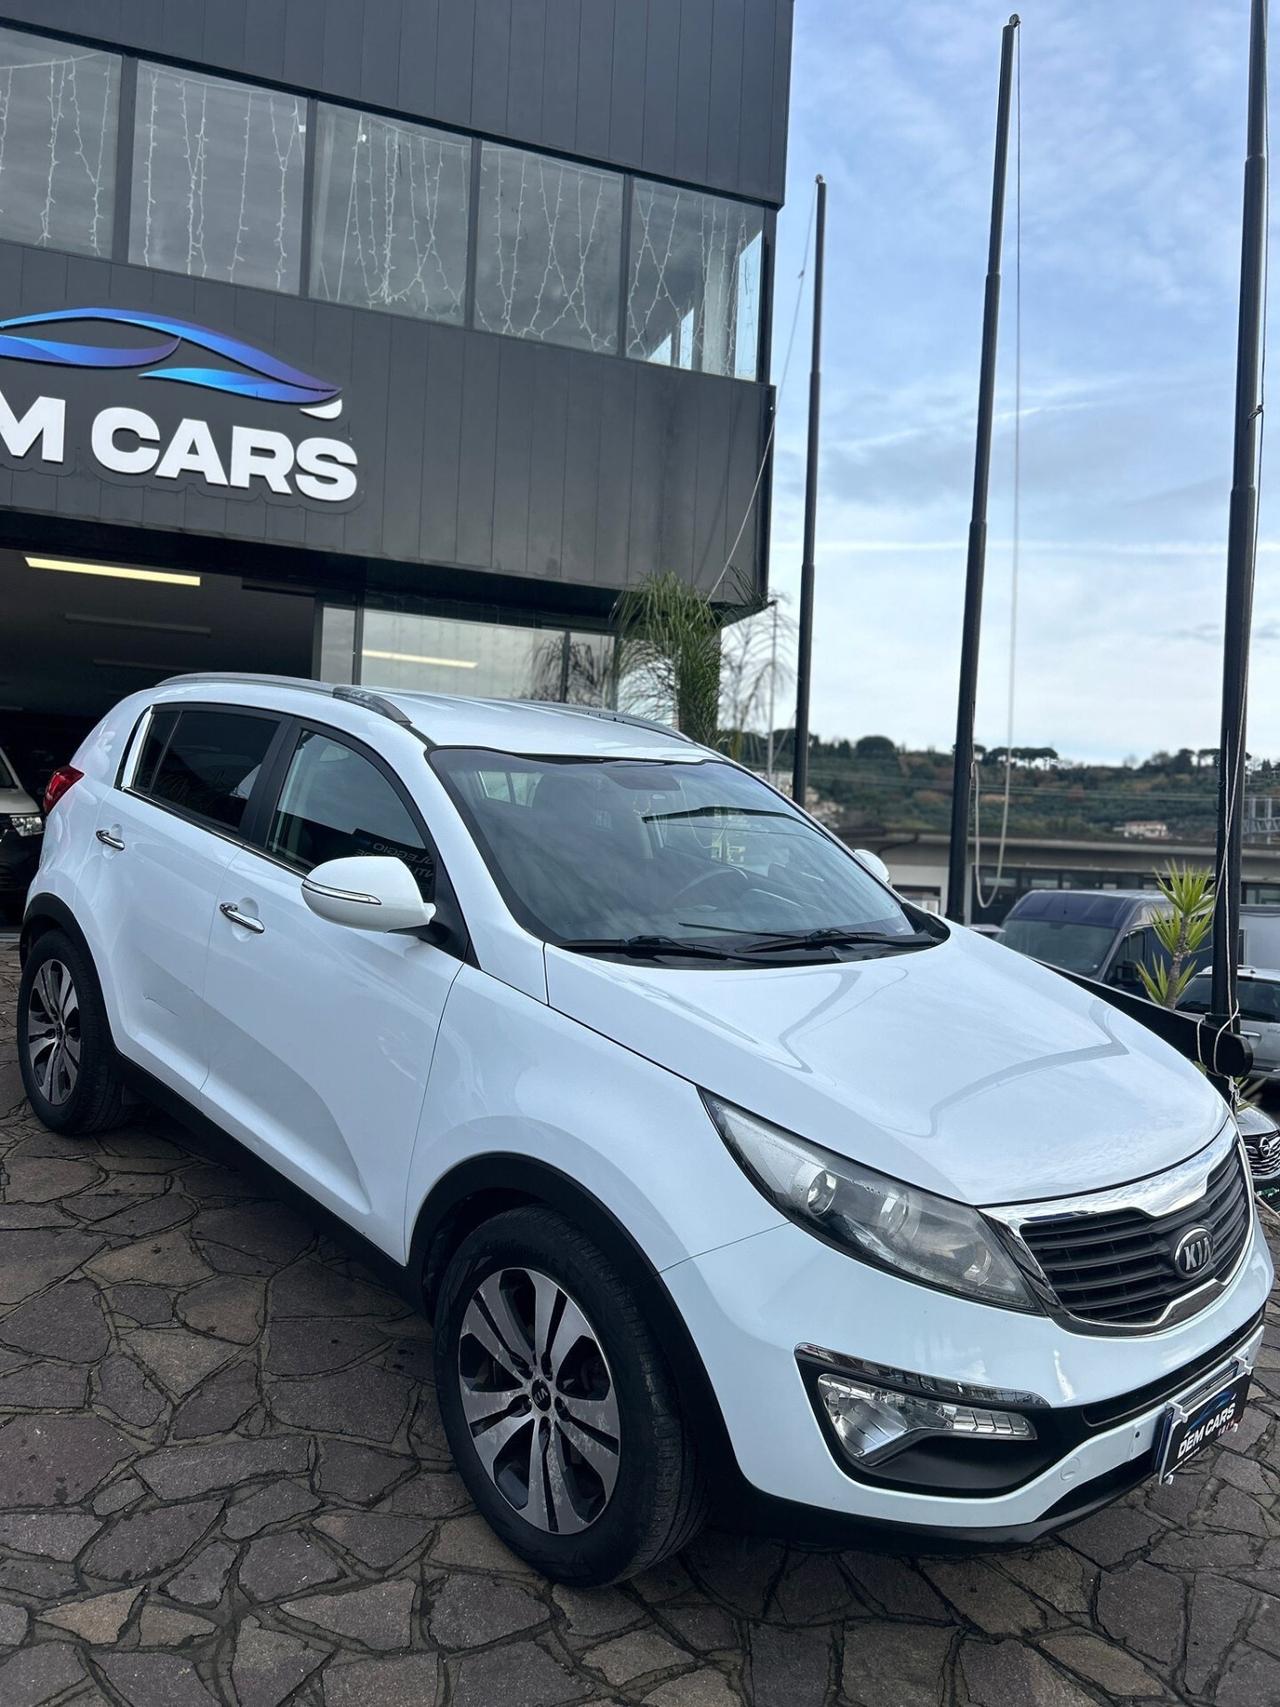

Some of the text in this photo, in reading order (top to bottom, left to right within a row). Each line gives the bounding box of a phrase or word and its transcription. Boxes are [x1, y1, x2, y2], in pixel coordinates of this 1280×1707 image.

[91, 406, 359, 502] CARS
[1184, 1236, 1211, 1271] KIA
[1177, 1425, 1205, 1460] DEM
[1205, 1402, 1236, 1437] CARS
